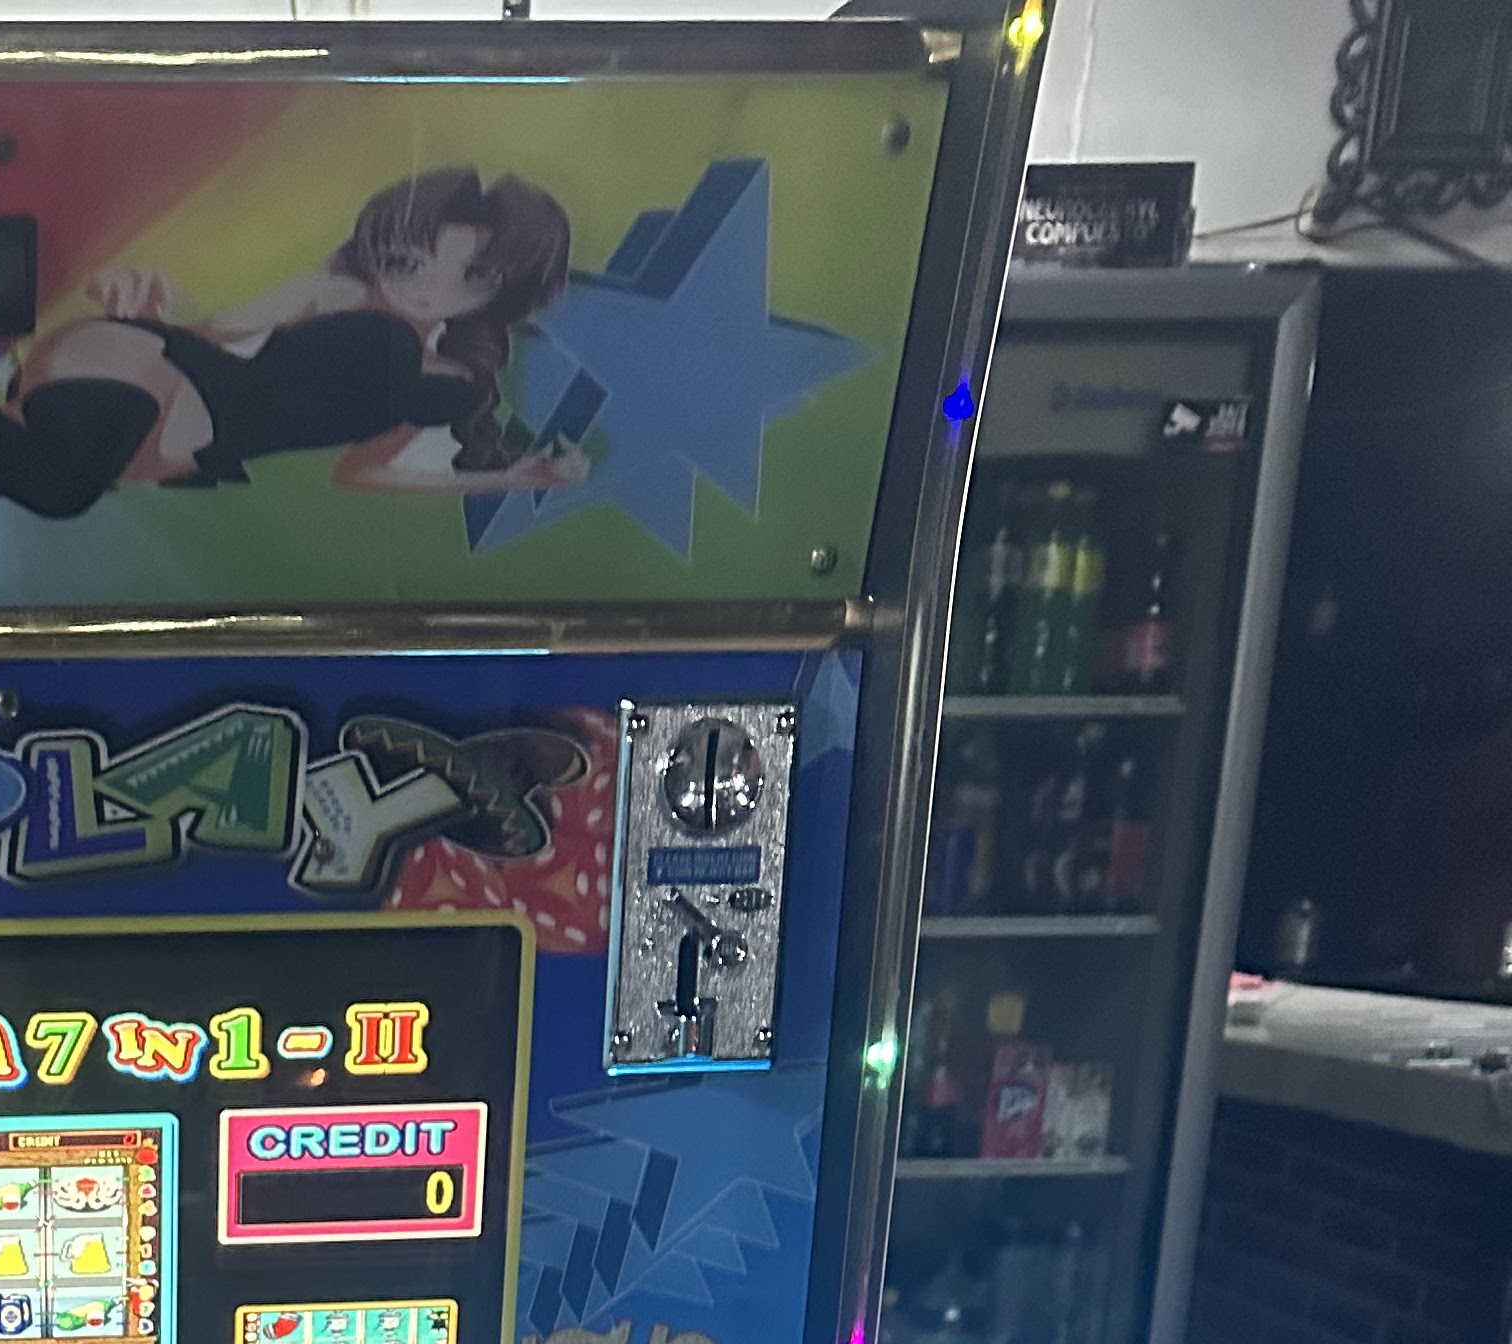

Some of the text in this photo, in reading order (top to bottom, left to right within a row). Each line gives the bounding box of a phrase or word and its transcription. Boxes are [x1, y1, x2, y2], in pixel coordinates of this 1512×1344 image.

[26, 1012, 96, 1084] 7
[105, 1014, 208, 1082] IN
[209, 1008, 270, 1079] 1
[248, 1120, 456, 1160] CREDIT
[425, 1172, 456, 1215] 0
